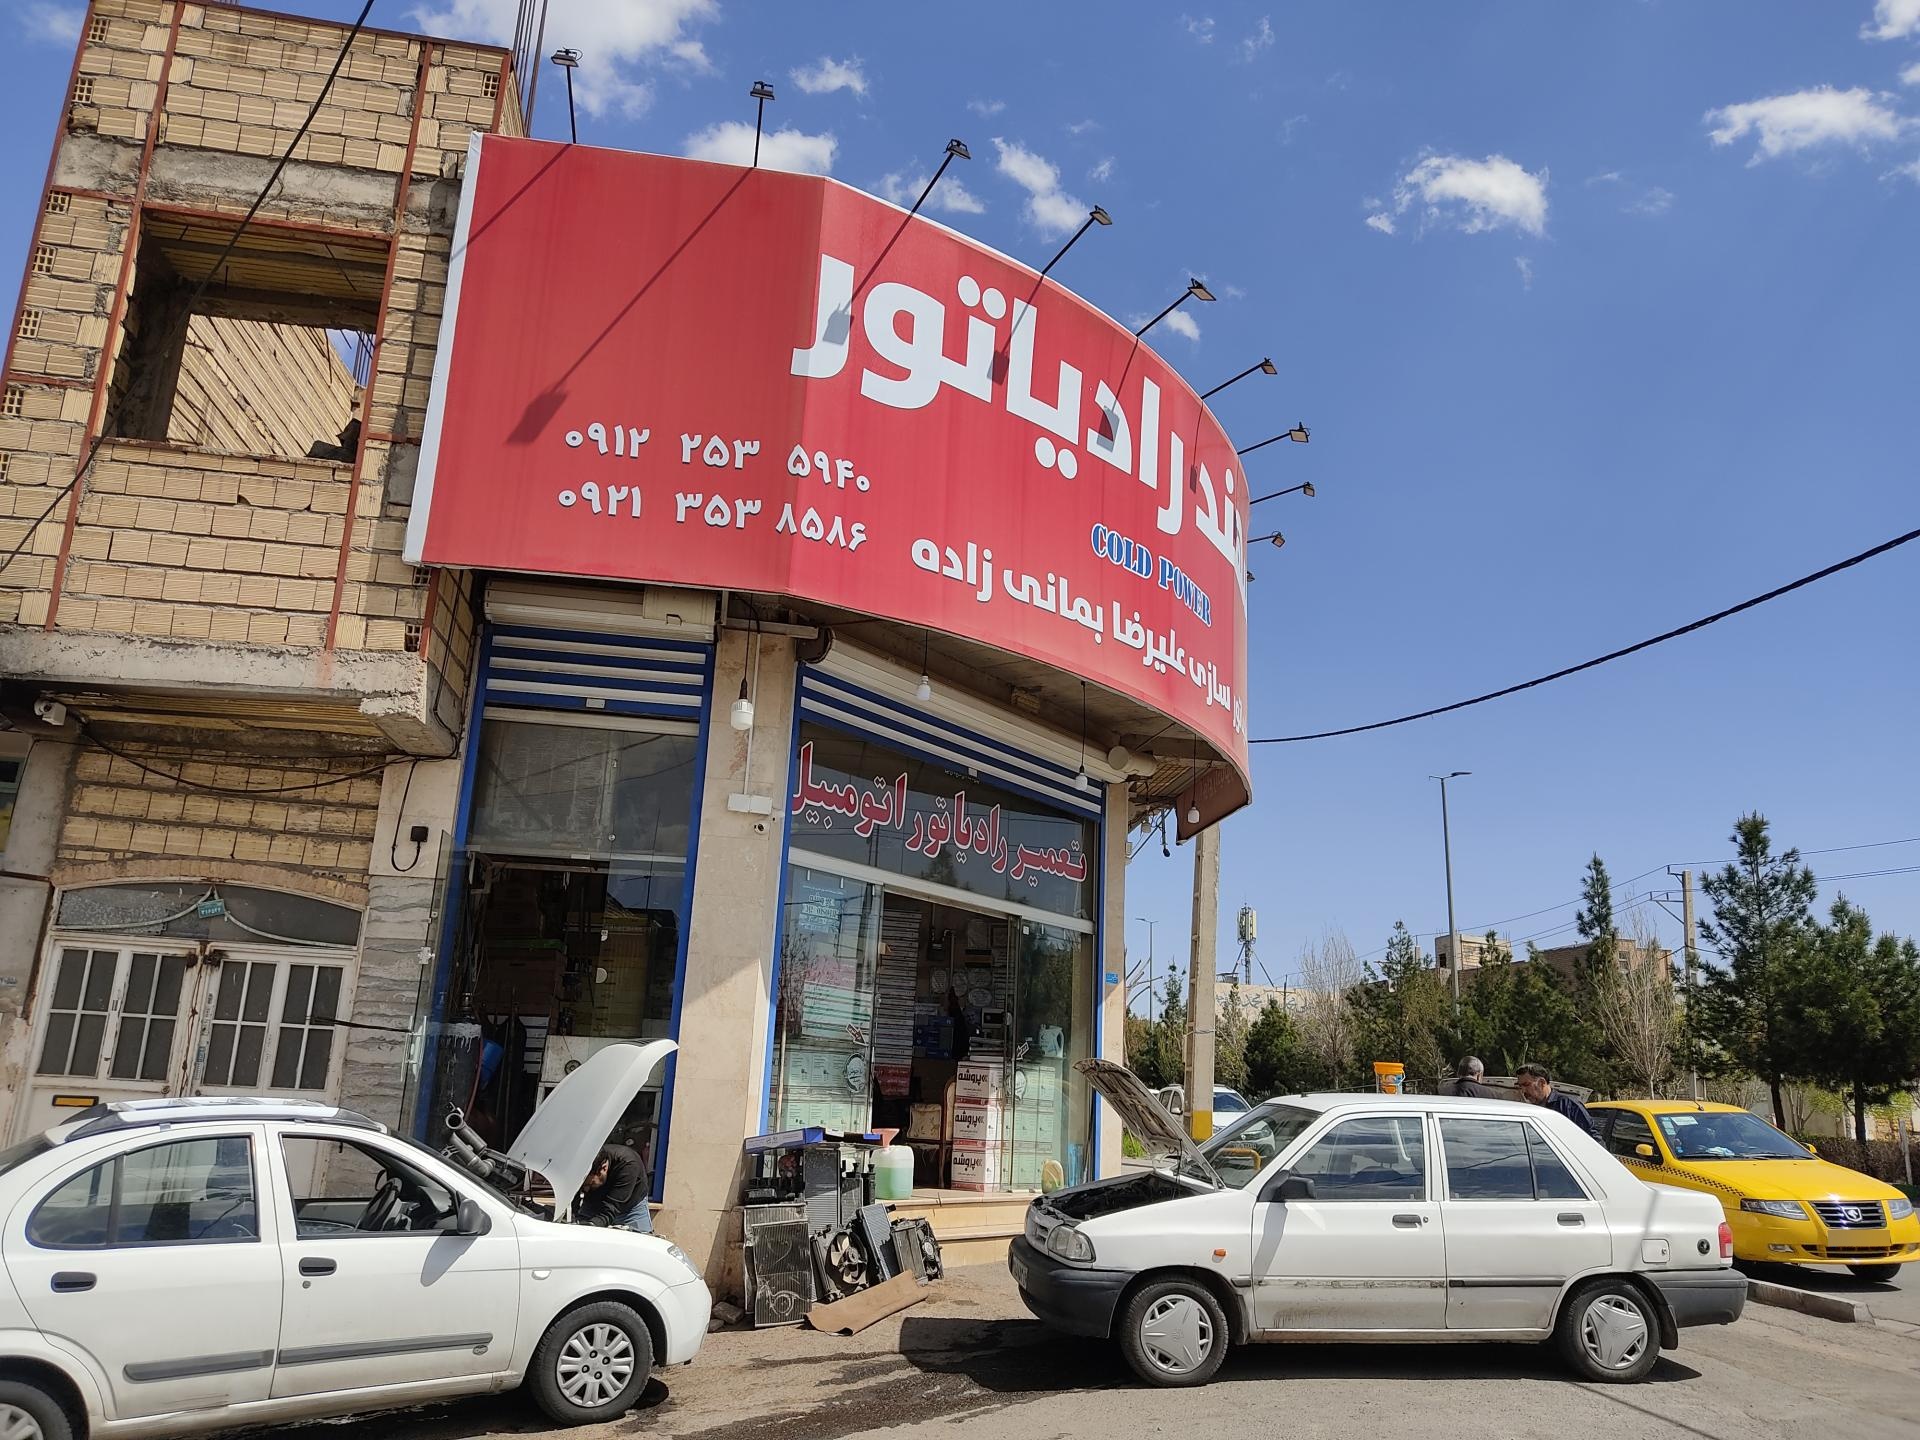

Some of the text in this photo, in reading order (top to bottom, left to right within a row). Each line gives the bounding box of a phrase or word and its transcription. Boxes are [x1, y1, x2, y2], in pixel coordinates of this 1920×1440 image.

[790, 253, 1184, 535] رادیاتور
[565, 422, 871, 492] ۰۹۱۲ ۲۵۳ ۵۹۴۰
[558, 481, 868, 551] ۰۹۲۱ ۳۵۳ ۸۵۸۶
[1092, 523, 1213, 627] COLD POWER
[911, 538, 1231, 711] سازی علیرضا بمانی زاده
[792, 740, 1087, 887] تعمیر رادیاتور اتومبیل
[958, 1069, 982, 1086] پروشه
[955, 1110, 978, 1128] پروشه
[953, 1153, 976, 1170] پروشه
